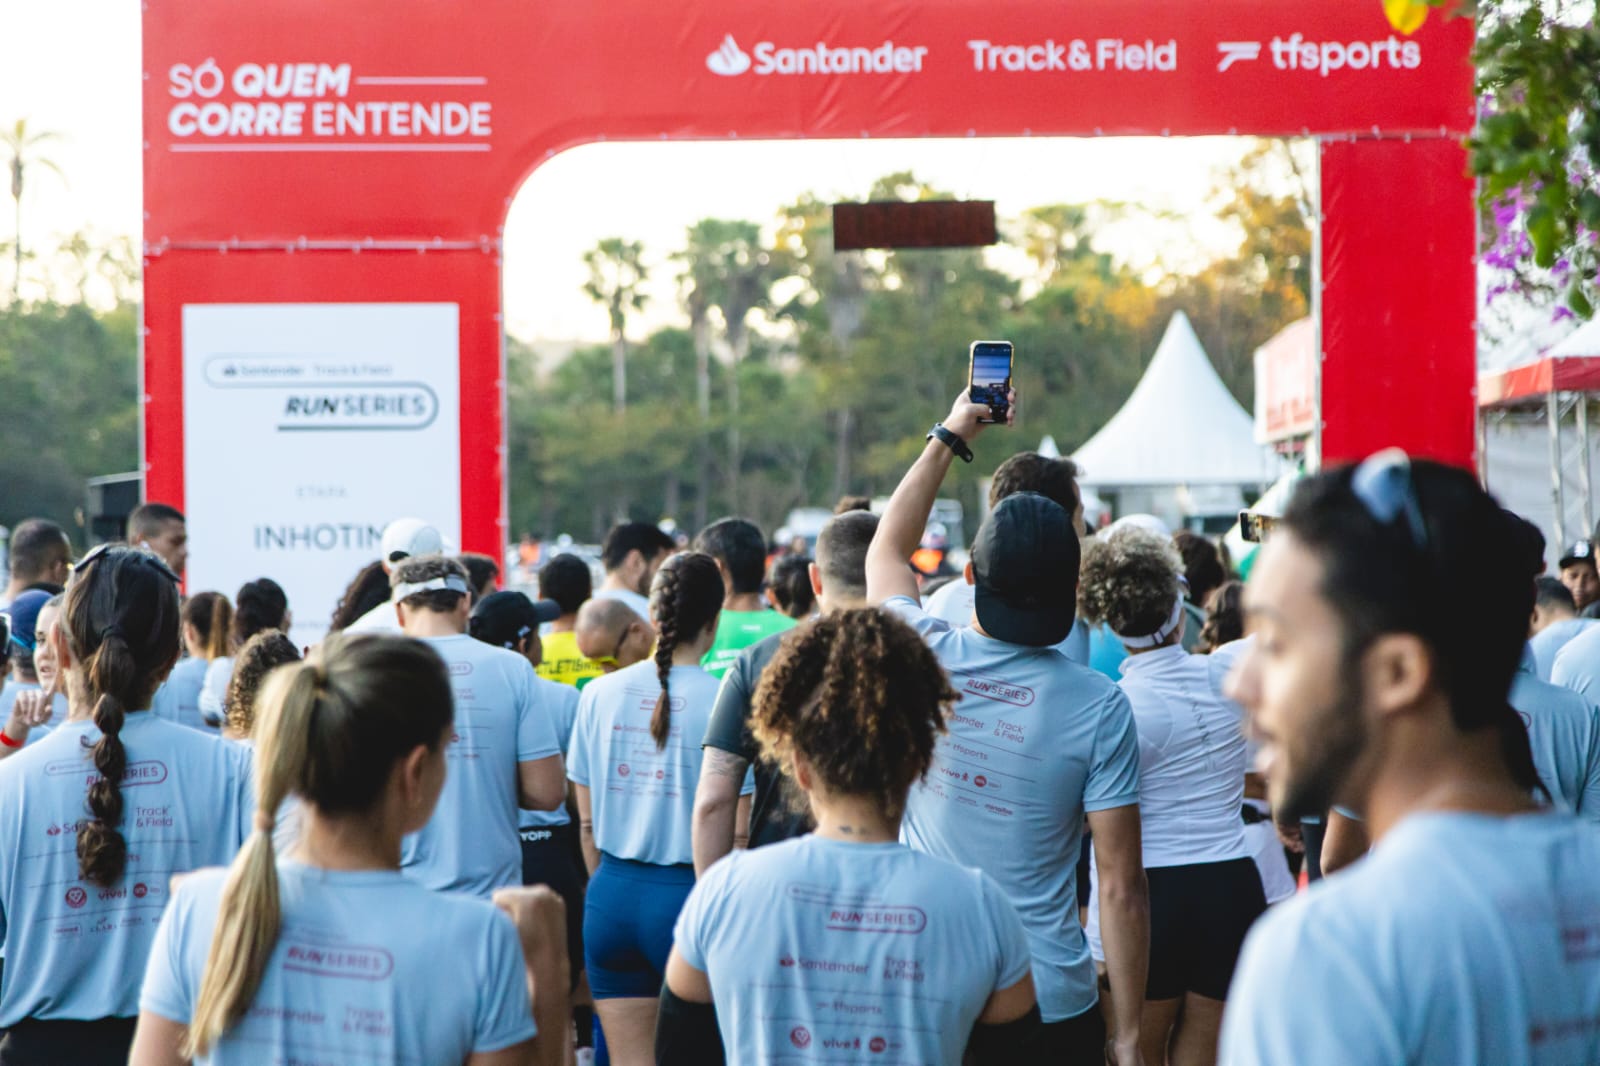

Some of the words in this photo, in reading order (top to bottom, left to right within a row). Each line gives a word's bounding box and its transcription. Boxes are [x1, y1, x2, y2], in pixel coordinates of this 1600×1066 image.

[753, 40, 928, 75] Santander
[1269, 32, 1421, 77] tfsports
[168, 57, 225, 98] SÓ
[232, 63, 352, 98] QUEM
[168, 102, 306, 136] CORRE
[313, 102, 492, 136] ENTENDE
